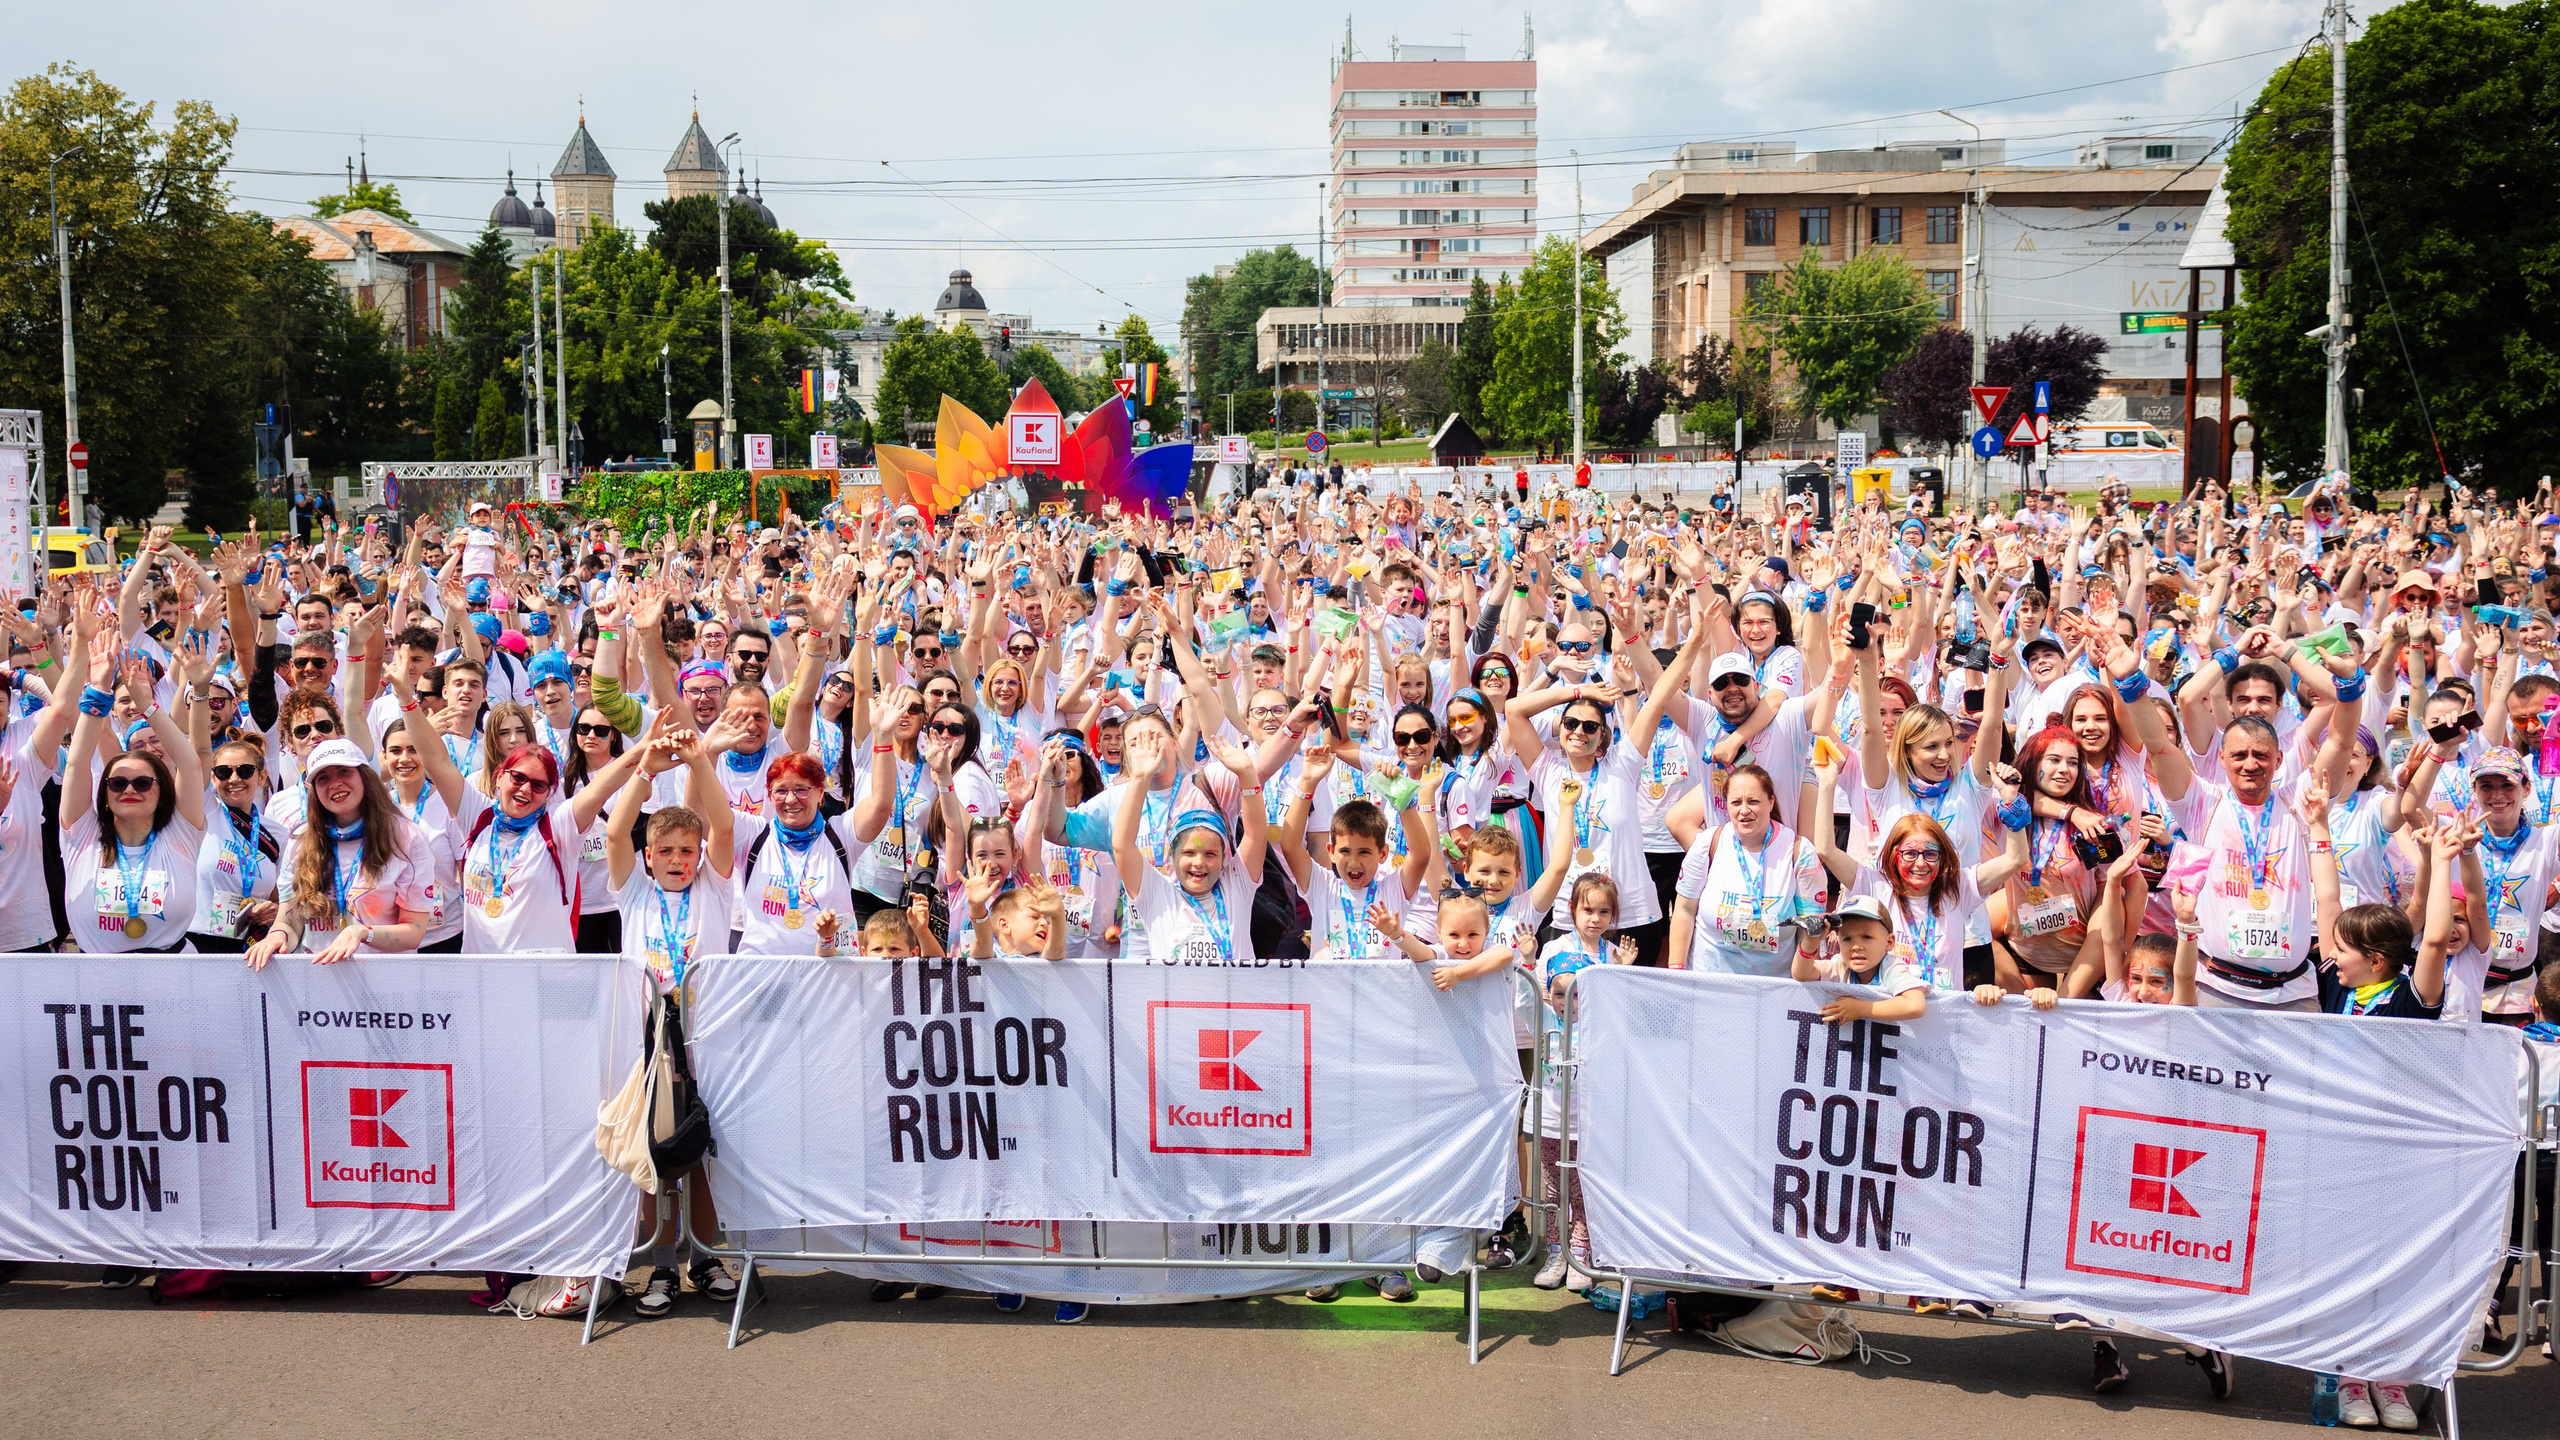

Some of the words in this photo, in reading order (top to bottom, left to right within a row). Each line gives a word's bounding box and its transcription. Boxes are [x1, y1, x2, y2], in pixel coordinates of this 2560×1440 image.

[1016, 446, 1053, 454] Kaufland
[315, 749, 346, 762] ARCADIS
[1721, 890, 1740, 906] THE
[2225, 880, 2249, 899] RUN
[98, 915, 124, 932] RUN
[2035, 912, 2065, 931] 18309
[1185, 941, 1218, 959] 15935
[2244, 928, 2278, 947] 15734
[298, 1010, 413, 1030] POWERED
[422, 1013, 452, 1031] BY
[44, 1003, 149, 1071] THE
[884, 1017, 1068, 1090] COLOR
[1787, 1009, 1900, 1097] THE
[2082, 1050, 2224, 1086] POWERED
[2235, 1070, 2272, 1093] BY
[49, 1075, 230, 1144] COLOR
[1168, 1105, 1292, 1129] Kaufland
[888, 1092, 999, 1163] RUN
[1776, 1088, 1985, 1187] COLOR
[55, 1145, 163, 1213] RUN
[321, 1161, 436, 1186] Kaufland
[1773, 1163, 1896, 1252] RUN
[2089, 1220, 2233, 1263] Kaufland
